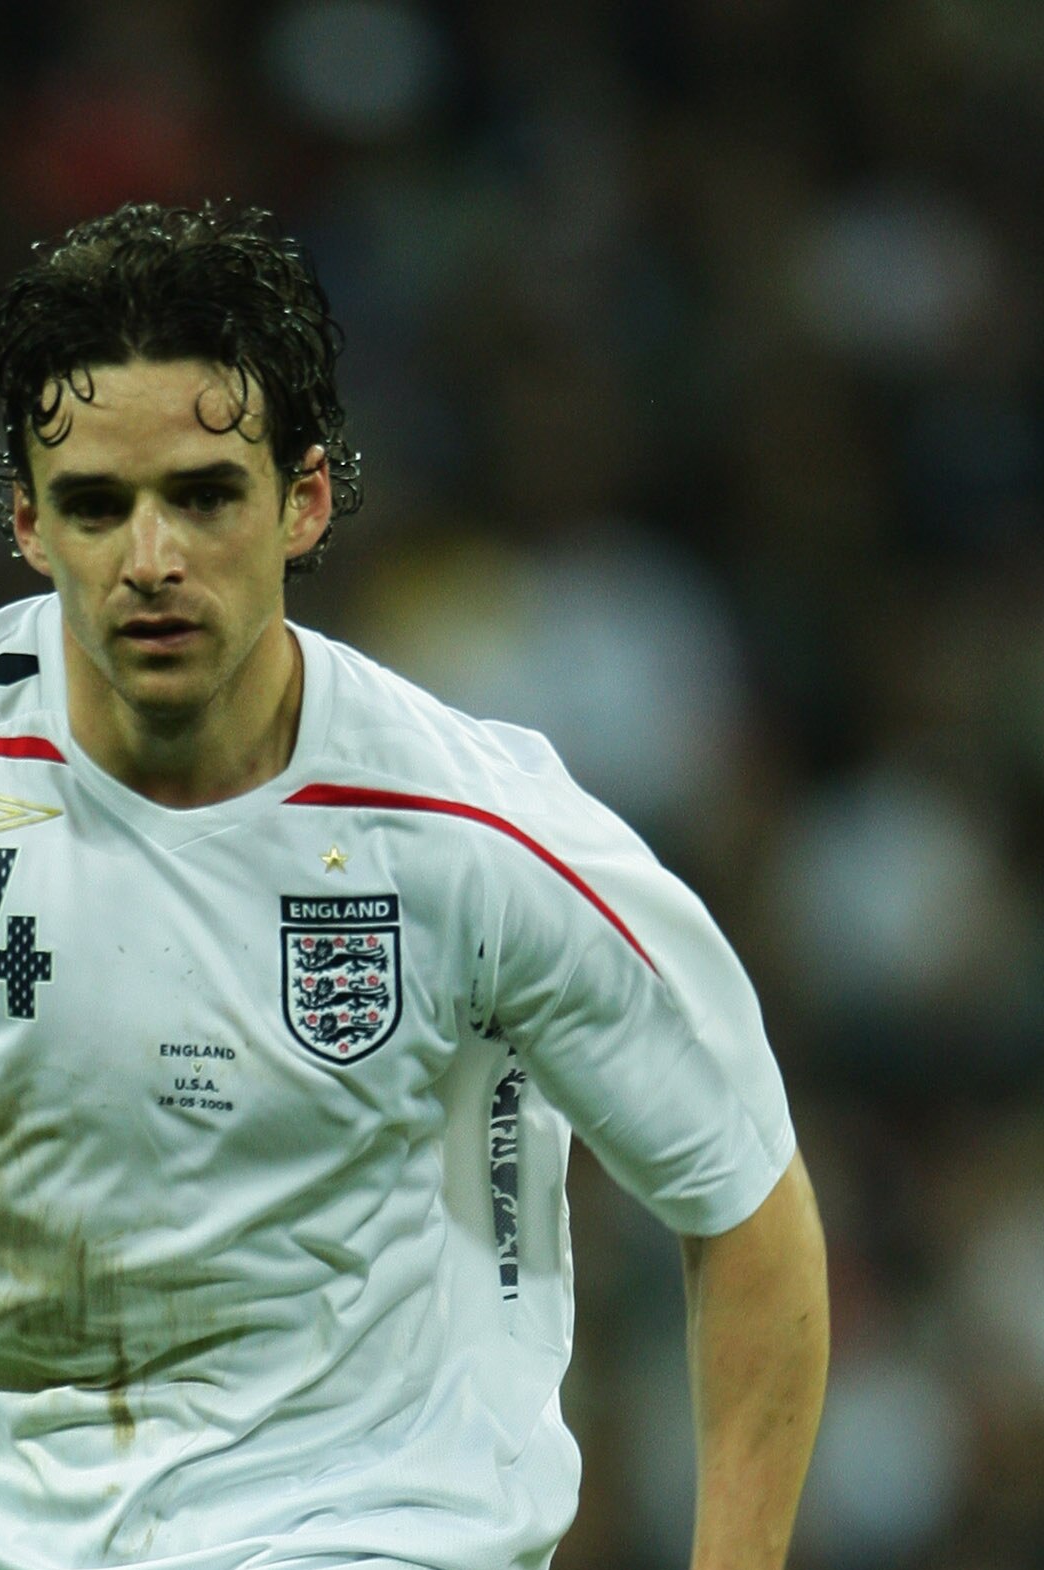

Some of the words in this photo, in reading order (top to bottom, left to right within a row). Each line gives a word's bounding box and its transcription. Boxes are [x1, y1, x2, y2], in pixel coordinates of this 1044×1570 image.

[289, 900, 391, 919] ENGLAND
[159, 1044, 236, 1060] ENGLAND
[174, 1078, 220, 1093] U.S.A.
